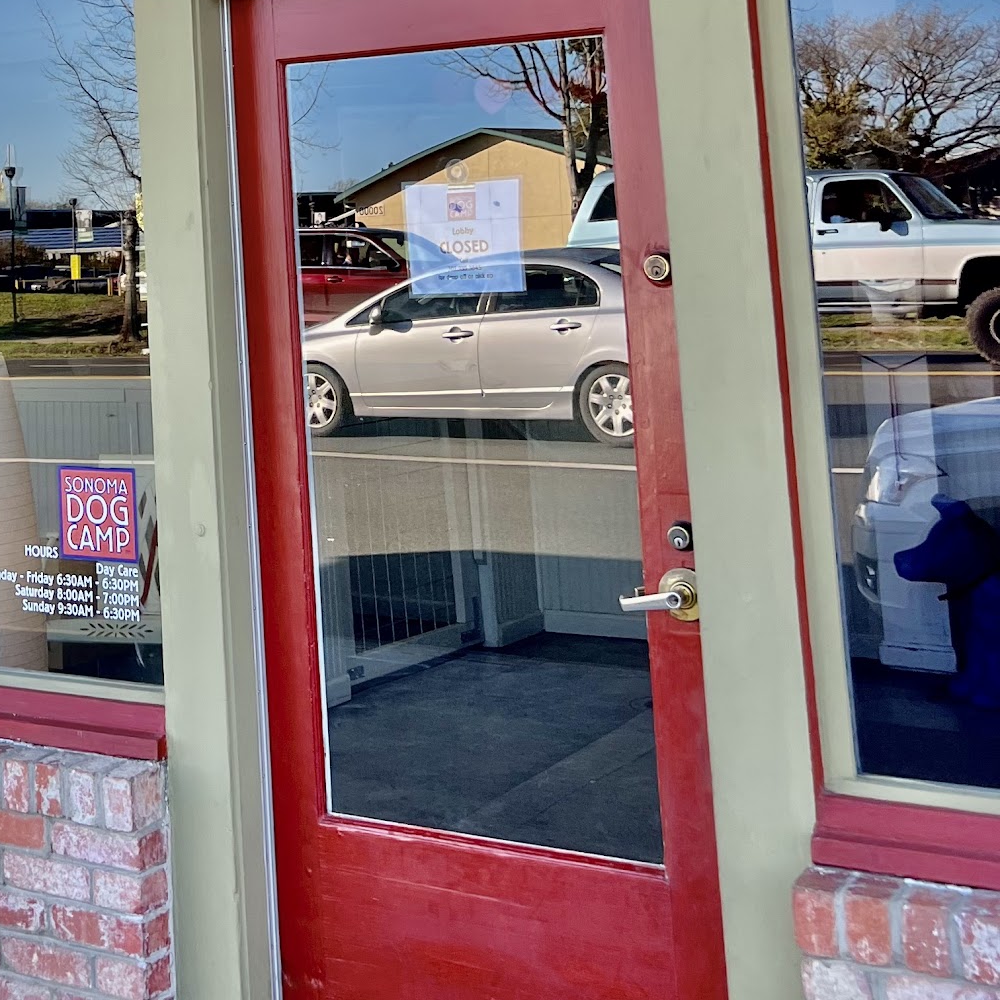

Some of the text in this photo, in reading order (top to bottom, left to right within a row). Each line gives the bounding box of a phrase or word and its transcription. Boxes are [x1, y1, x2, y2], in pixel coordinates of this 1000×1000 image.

[440, 240, 489, 254] CLOSED
[65, 476, 128, 494] SONOMA
[66, 493, 129, 526] DOG
[67, 523, 130, 553] CAMP
[24, 544, 59, 559] HOURS
[26, 570, 54, 586] Friday
[56, 574, 92, 588] 6:30AM
[102, 578, 139, 592] 6:30PM
[96, 562, 138, 578] Day Care
[15, 584, 54, 600] Saturday
[56, 588, 94, 603] 8:00AM
[103, 593, 140, 607] 7:00PM
[22, 599, 55, 614] Sunday
[57, 602, 94, 618] 9:30AM
[103, 608, 140, 622] 6:30PM
